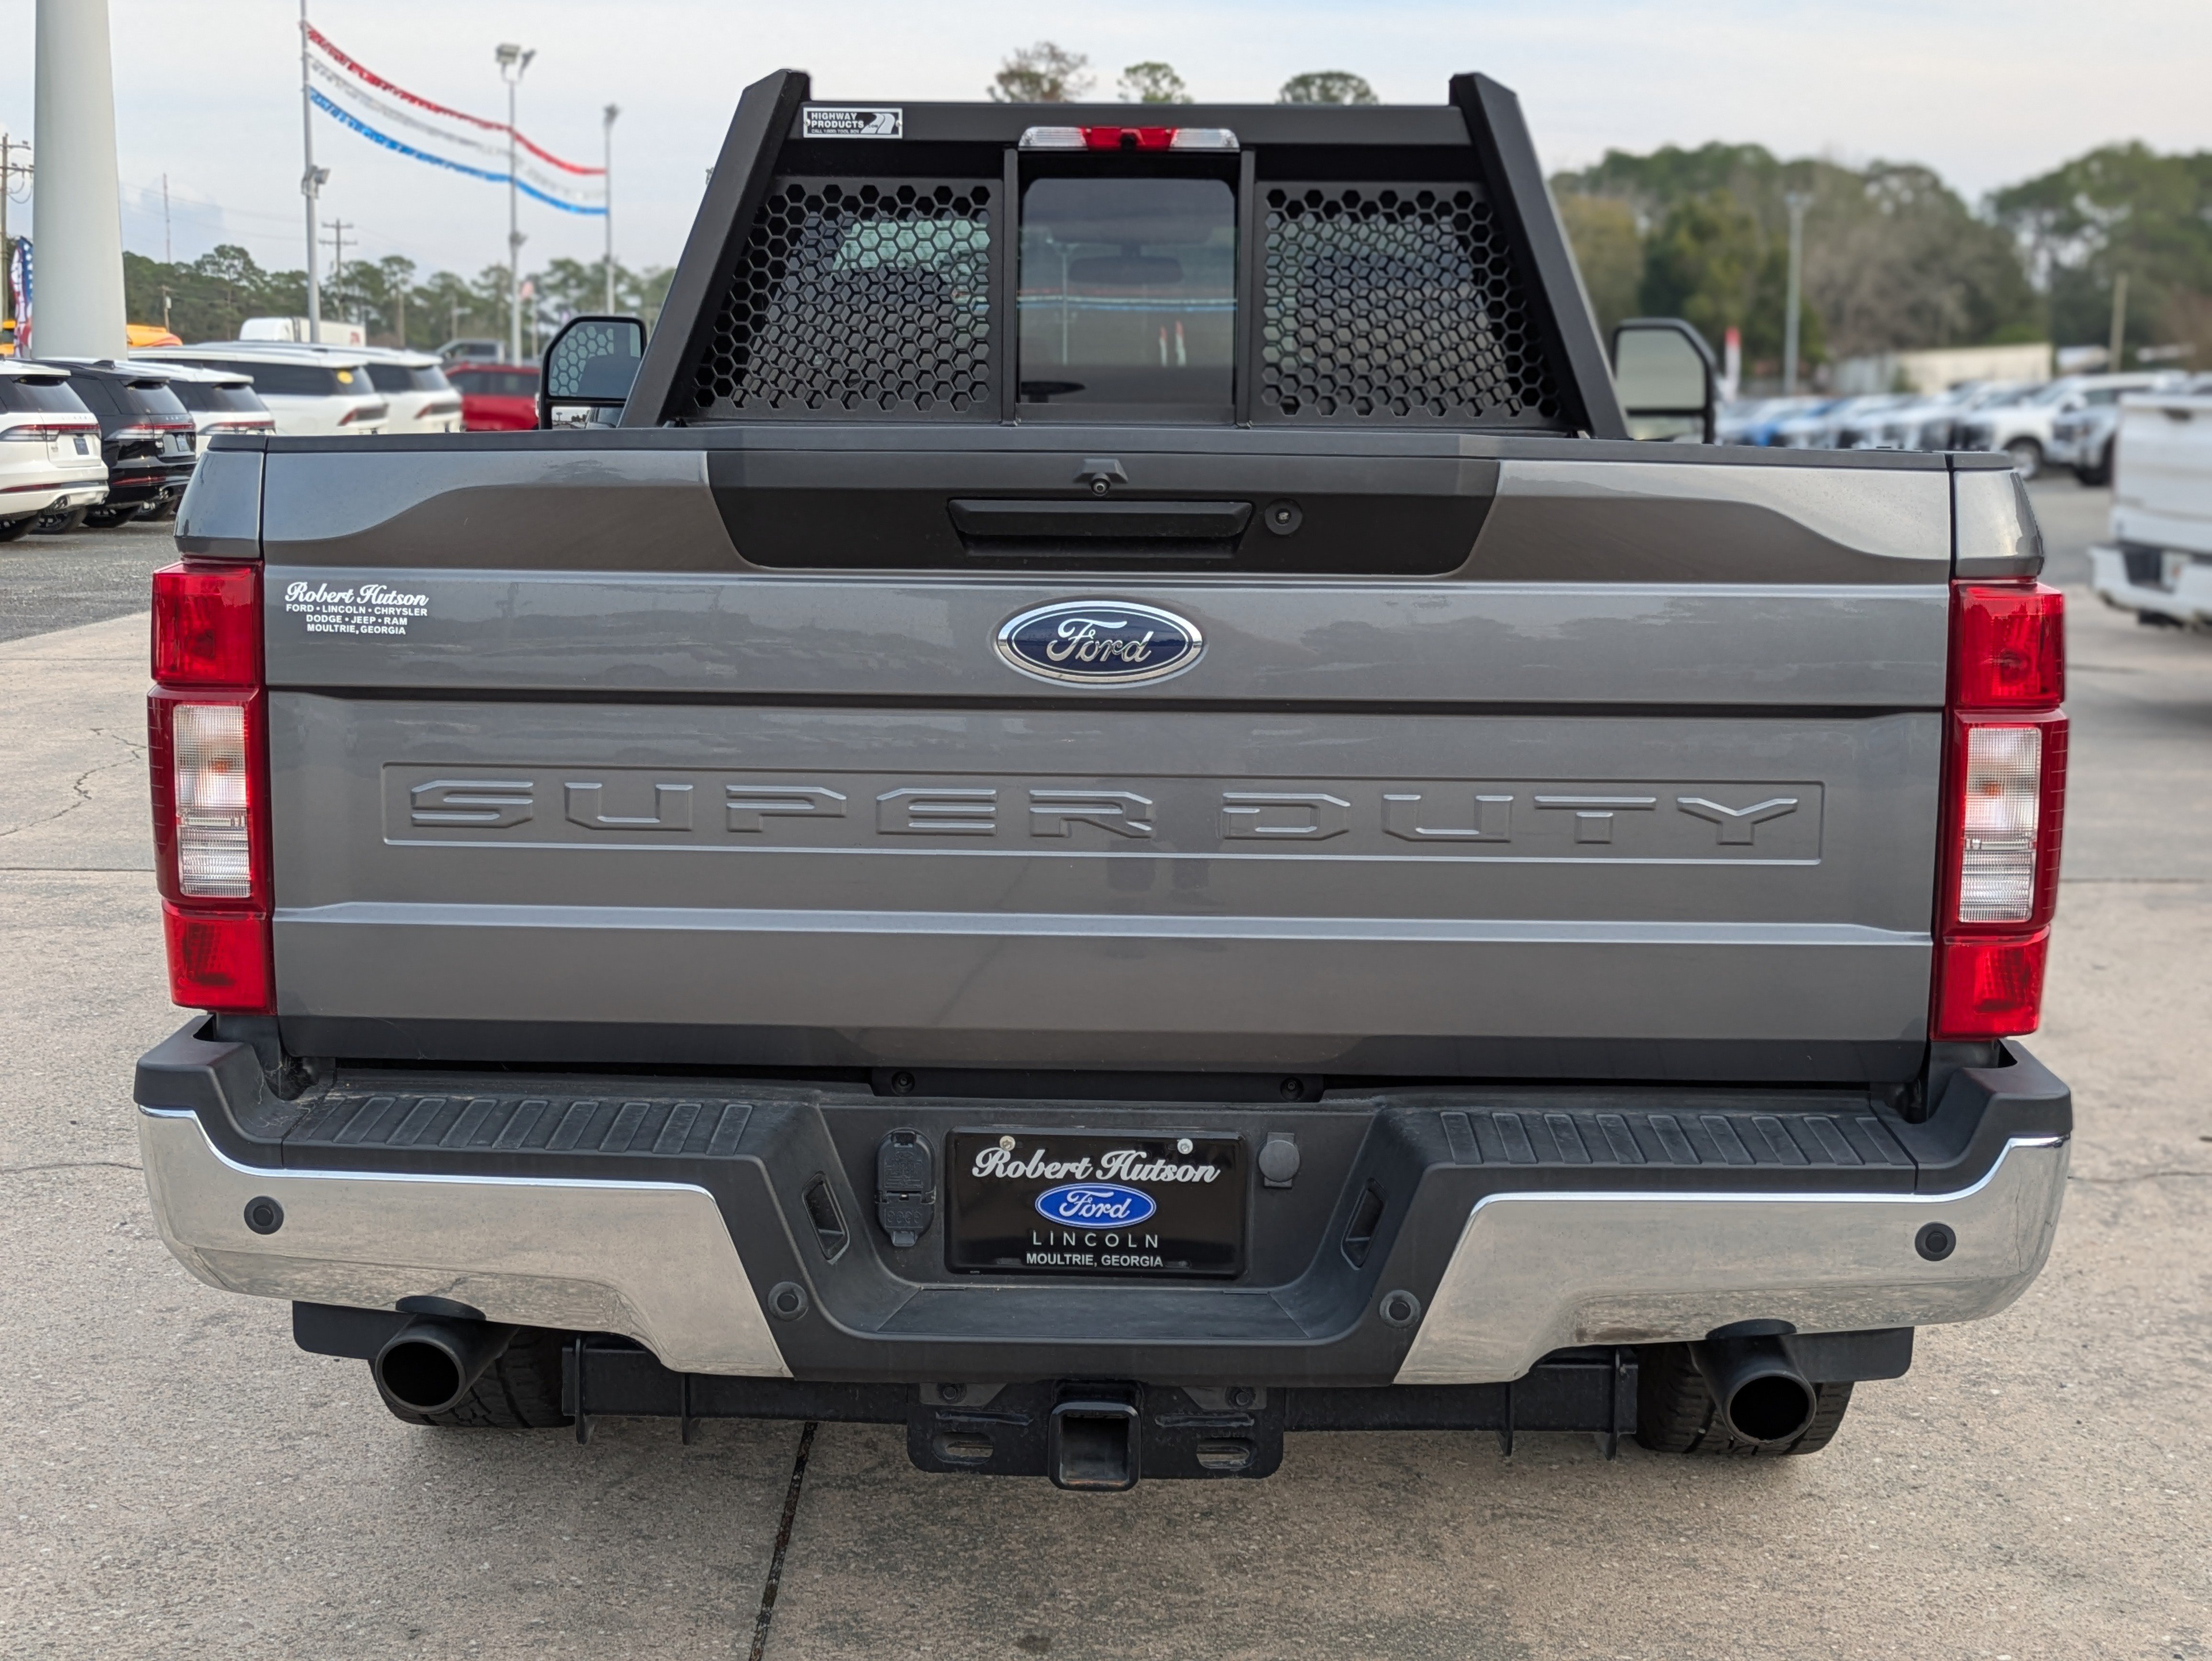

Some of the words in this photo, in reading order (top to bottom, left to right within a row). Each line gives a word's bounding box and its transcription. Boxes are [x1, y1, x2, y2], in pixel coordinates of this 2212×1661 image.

[285, 581, 355, 604] Robert
[356, 584, 429, 607] Hutson
[286, 604, 314, 612] FORD
[322, 605, 366, 614] LINCOLN
[374, 607, 428, 616] CHRYSLER
[306, 614, 343, 623] DODGE
[351, 615, 376, 624] JEEP
[384, 617, 408, 625] RAM
[307, 623, 359, 634] MOULTRIE,
[360, 626, 406, 635] GEORGIA
[1046, 618, 1154, 663] Ford
[410, 779, 1154, 839] SUPER
[1220, 792, 1799, 845] DUTY
[972, 1147, 1093, 1180] Robert
[1095, 1150, 1221, 1183] Hutson
[1058, 1190, 1132, 1219] Ford
[1032, 1230, 1159, 1249] LINCOLN
[1026, 1252, 1097, 1268] MOULTRIE,
[1101, 1255, 1163, 1268] GEORGIA
